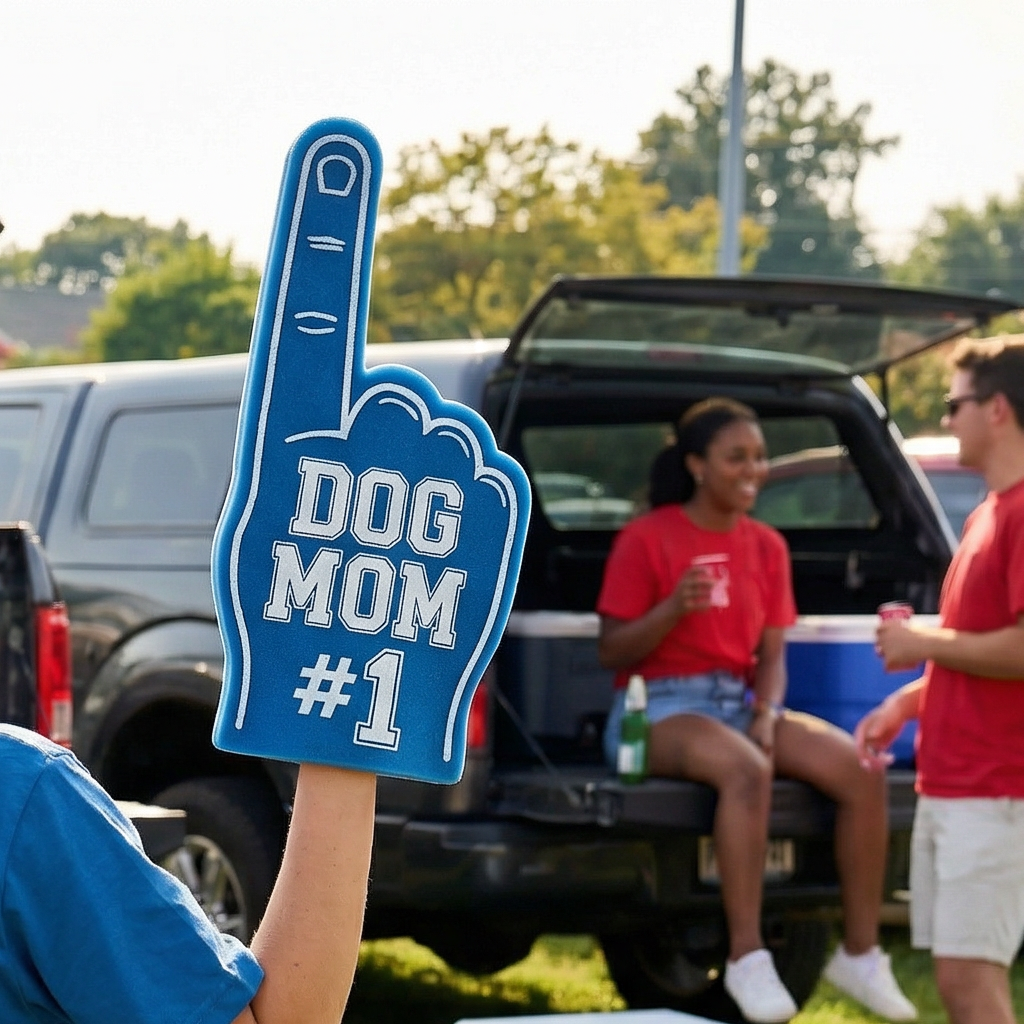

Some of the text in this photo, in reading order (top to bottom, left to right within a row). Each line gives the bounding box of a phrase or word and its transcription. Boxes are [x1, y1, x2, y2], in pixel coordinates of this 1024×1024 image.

[290, 456, 464, 558] DOG
[263, 541, 466, 649] MOM
[292, 648, 405, 751] #1
